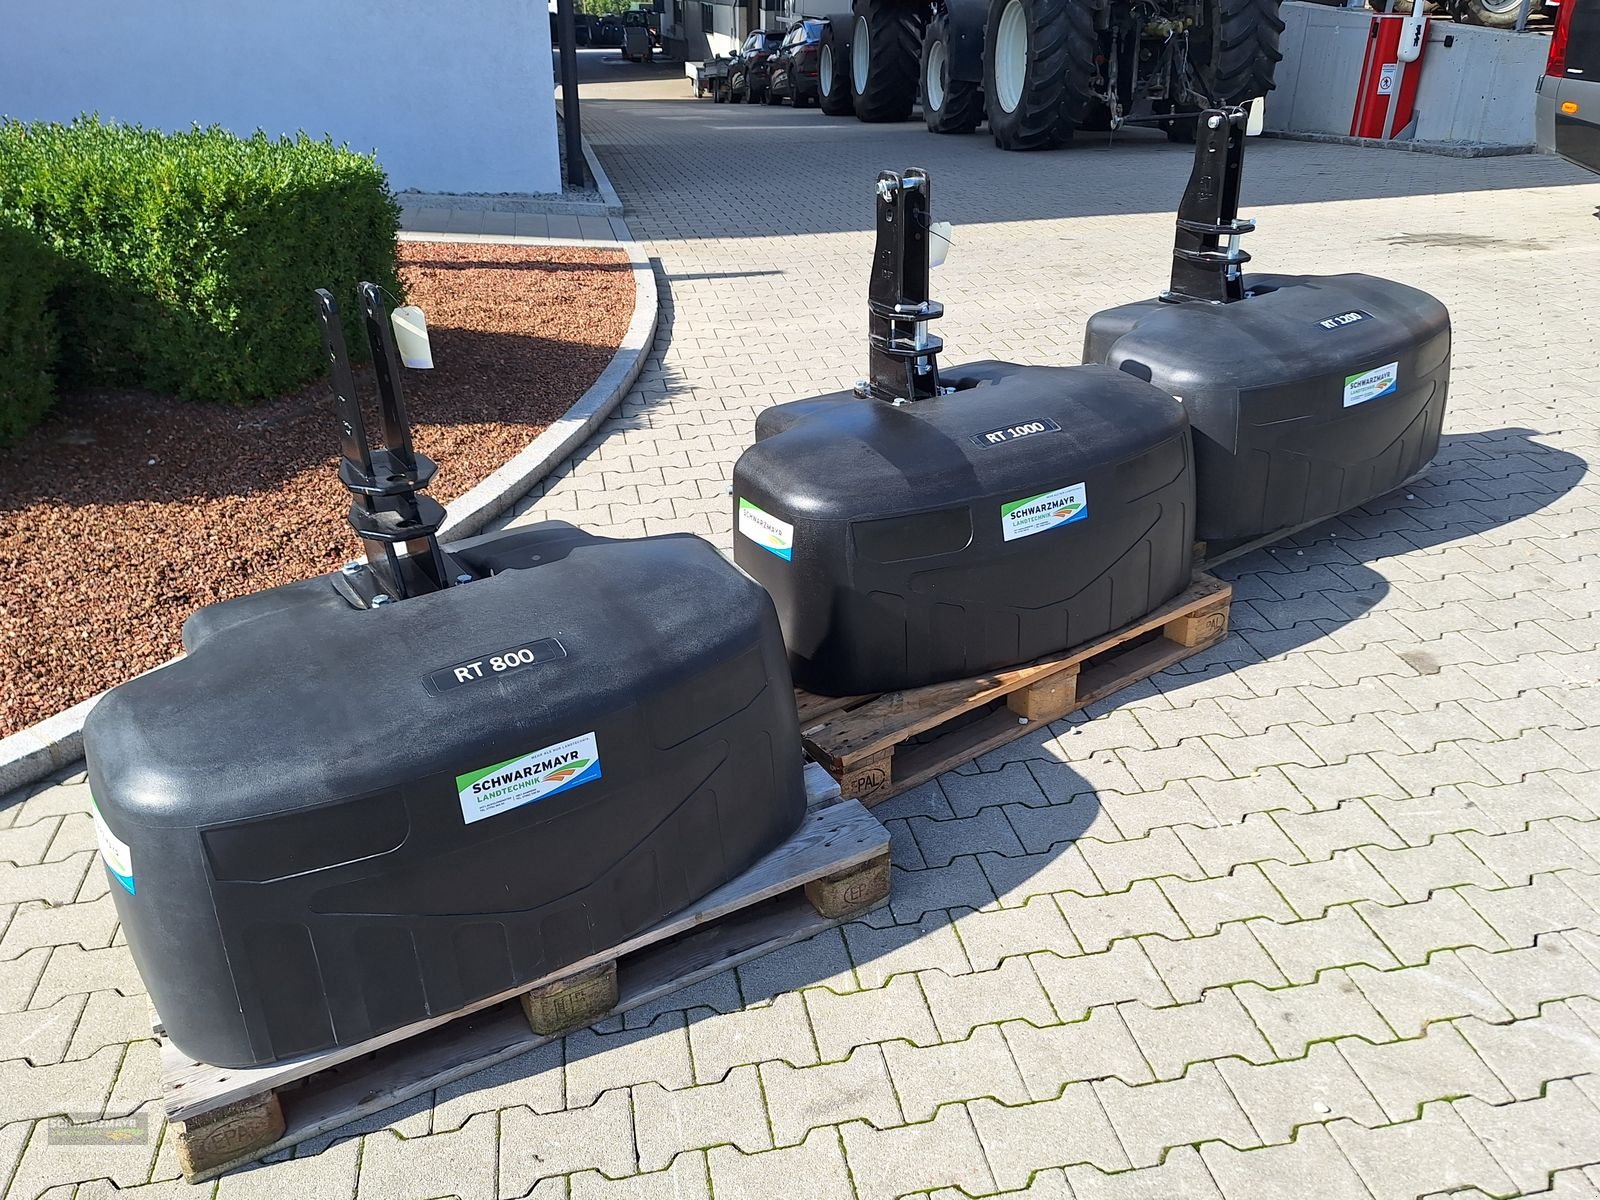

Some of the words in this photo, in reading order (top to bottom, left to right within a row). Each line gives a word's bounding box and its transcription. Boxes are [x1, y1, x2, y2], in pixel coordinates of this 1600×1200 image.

[1334, 312, 1363, 324] 1200
[1350, 371, 1391, 390] SCHWARZMAYR
[985, 431, 1007, 443] RT
[1007, 422, 1045, 438] 1000
[1010, 495, 1075, 520] SCHWARZMAYR
[1012, 512, 1051, 527] LANDTECHNIK
[453, 662, 483, 683] RT
[489, 648, 535, 672] 800
[472, 750, 579, 794] SCHWARZMAYR
[476, 777, 541, 803] LANDTECHNIK
